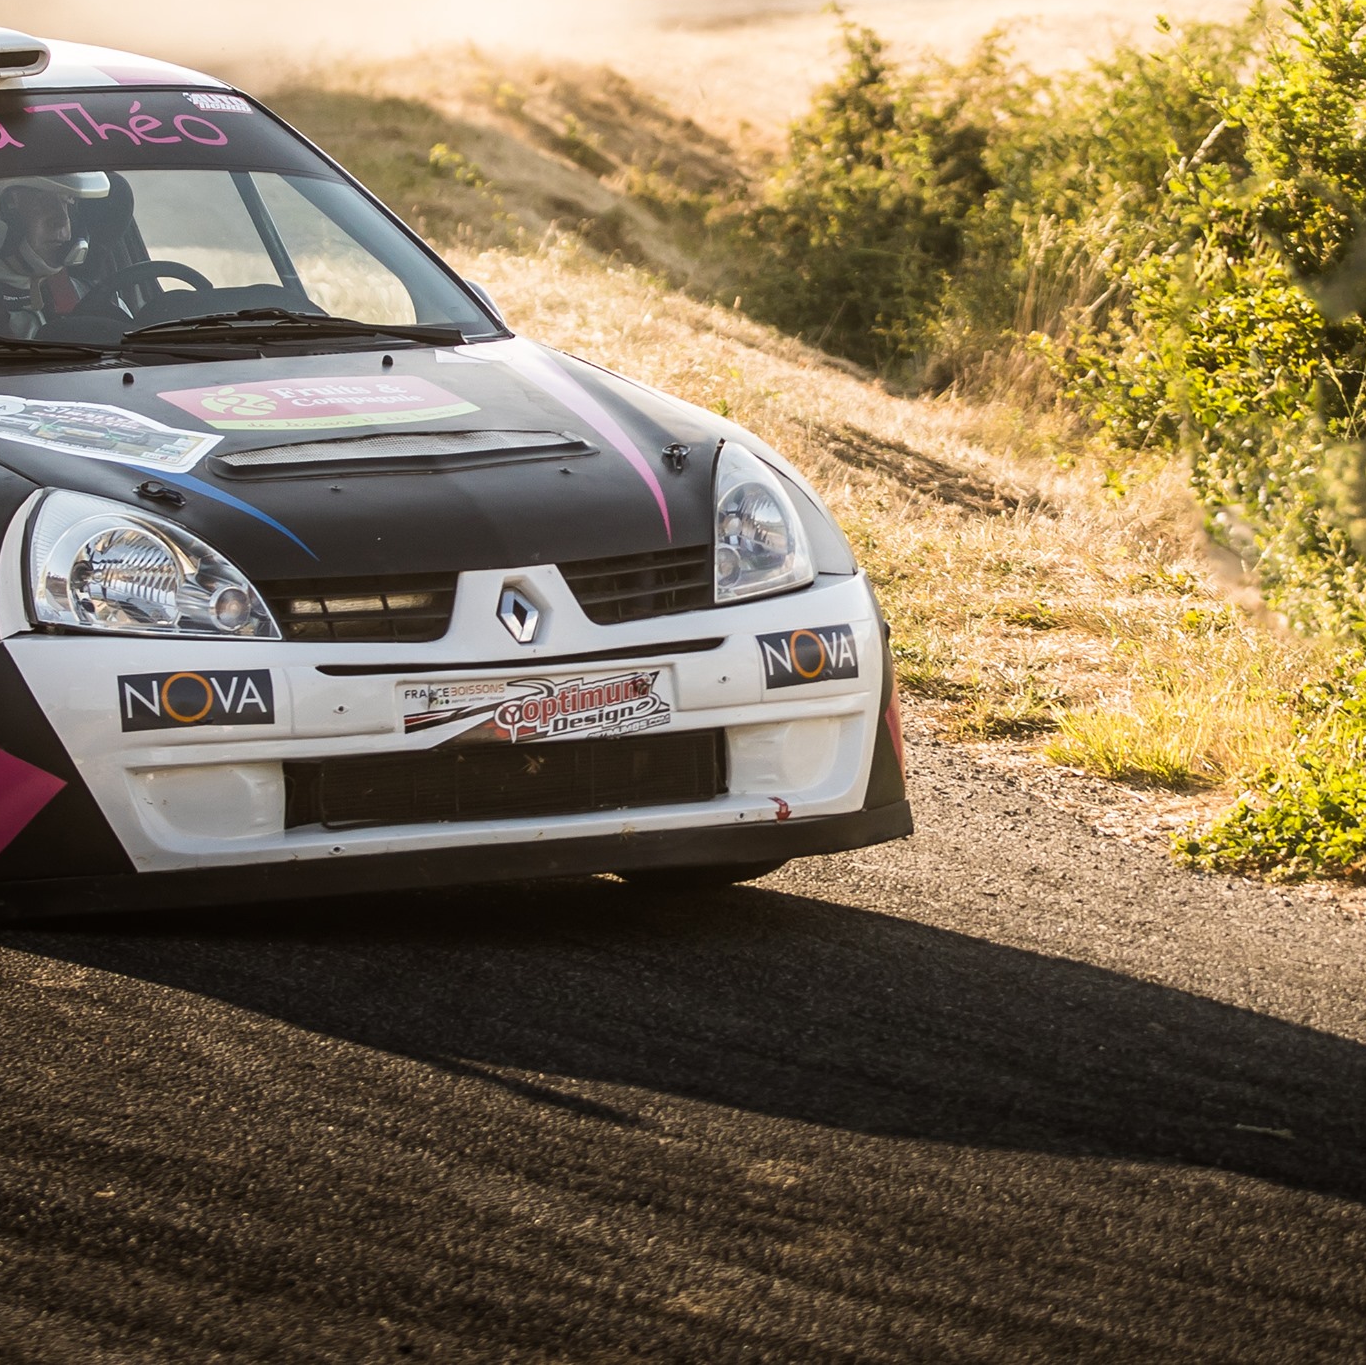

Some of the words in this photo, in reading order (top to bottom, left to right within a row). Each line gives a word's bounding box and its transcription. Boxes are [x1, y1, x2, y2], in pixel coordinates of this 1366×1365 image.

[23, 102, 228, 146] Théo
[268, 384, 372, 399] Fruits
[376, 383, 408, 394] &
[291, 394, 425, 407] Compagnie
[762, 629, 855, 679] NOVA
[124, 672, 267, 722] NOVA
[404, 687, 450, 700] FRACE
[522, 676, 650, 727] optimum
[553, 706, 634, 732] Design
